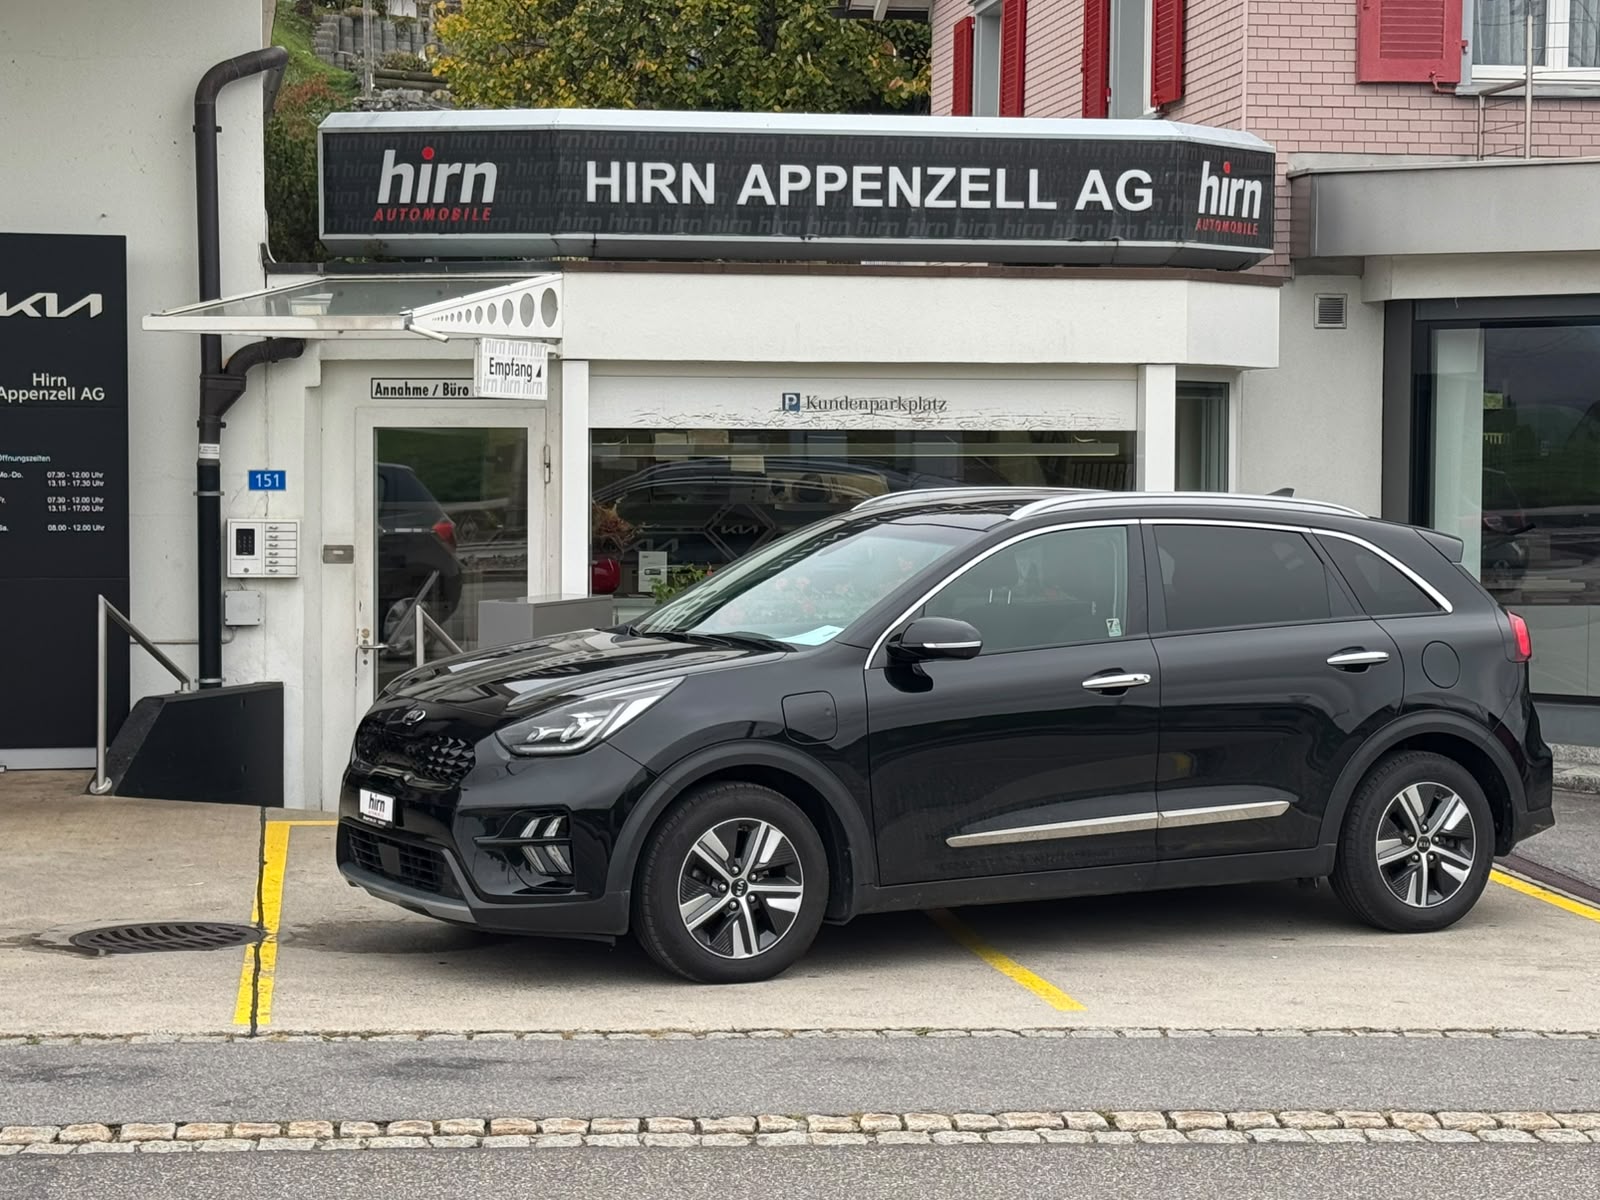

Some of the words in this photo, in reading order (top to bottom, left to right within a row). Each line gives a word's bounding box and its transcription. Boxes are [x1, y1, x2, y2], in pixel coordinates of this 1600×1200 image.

[377, 147, 498, 205] hirn
[586, 160, 715, 206] HIRN
[737, 163, 1057, 211] APPENZELL
[1074, 168, 1153, 212] AG
[1197, 160, 1263, 219] hirn
[373, 207, 493, 222] AUTOMOBILE
[1195, 217, 1259, 237] AUTOMOBILE
[489, 357, 533, 383] Empfang
[32, 372, 67, 387] Hirn
[375, 381, 429, 396] Annahme
[432, 384, 439, 396] /
[443, 382, 469, 396] Büro
[0, 386, 76, 403] Appenzell
[80, 387, 105, 401] AG
[806, 395, 948, 415] Kundenparkplatz
[46, 471, 66, 479] 07.30
[71, 471, 90, 479] 12.00
[91, 471, 104, 479] Uhr
[255, 473, 280, 488] 151
[73, 524, 91, 532] 12.00
[92, 524, 105, 532] Uhr
[368, 792, 386, 813] hirn
